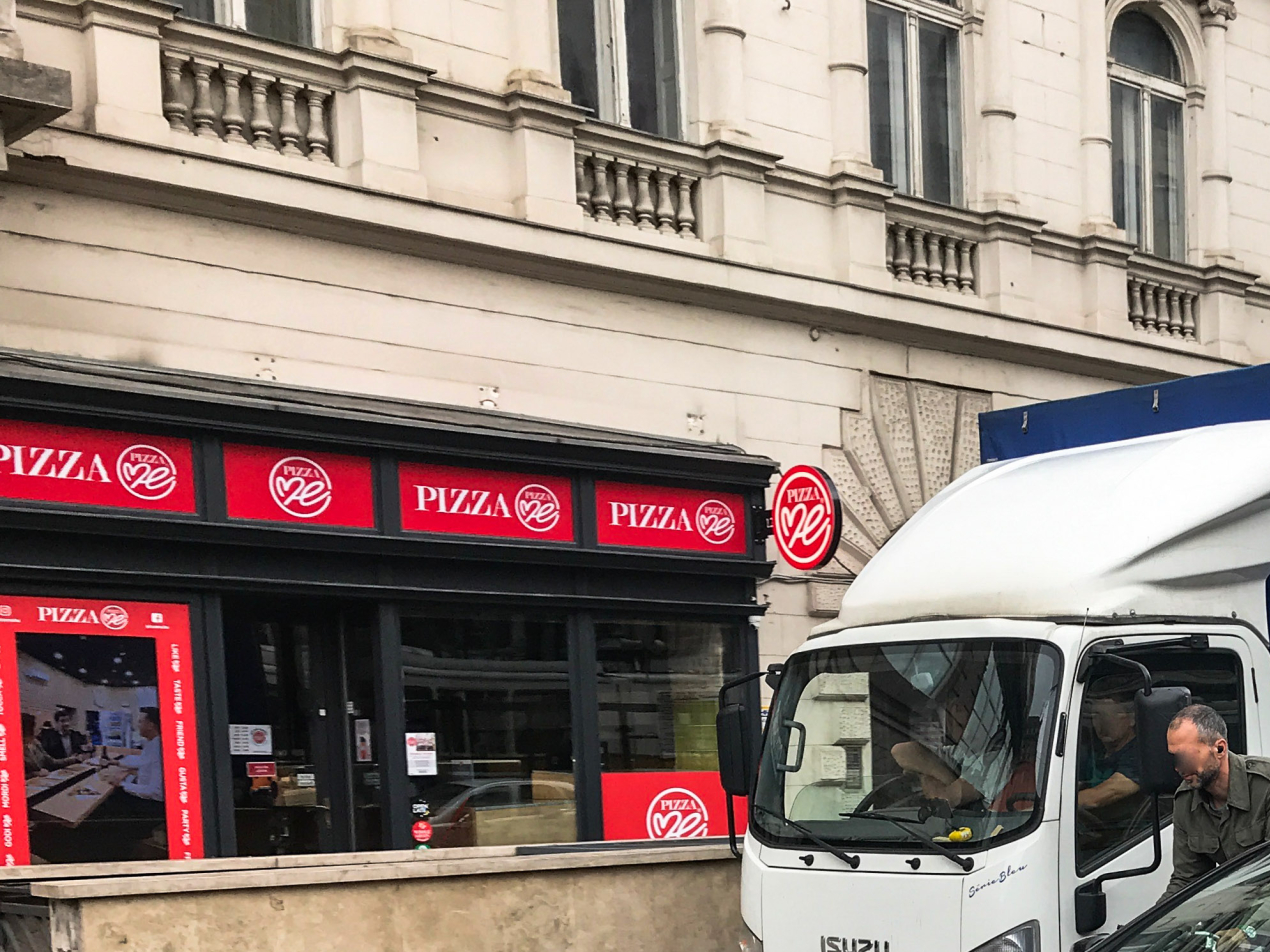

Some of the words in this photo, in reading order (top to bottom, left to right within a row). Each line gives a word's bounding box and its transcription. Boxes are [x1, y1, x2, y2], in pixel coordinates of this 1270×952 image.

[283, 465, 321, 479] PIZZA
[413, 485, 512, 518] PIZZA
[786, 486, 821, 503] PIZZA
[608, 501, 694, 532] PIZZA
[37, 606, 100, 624] PIZZA
[660, 799, 698, 811] PIZZA
